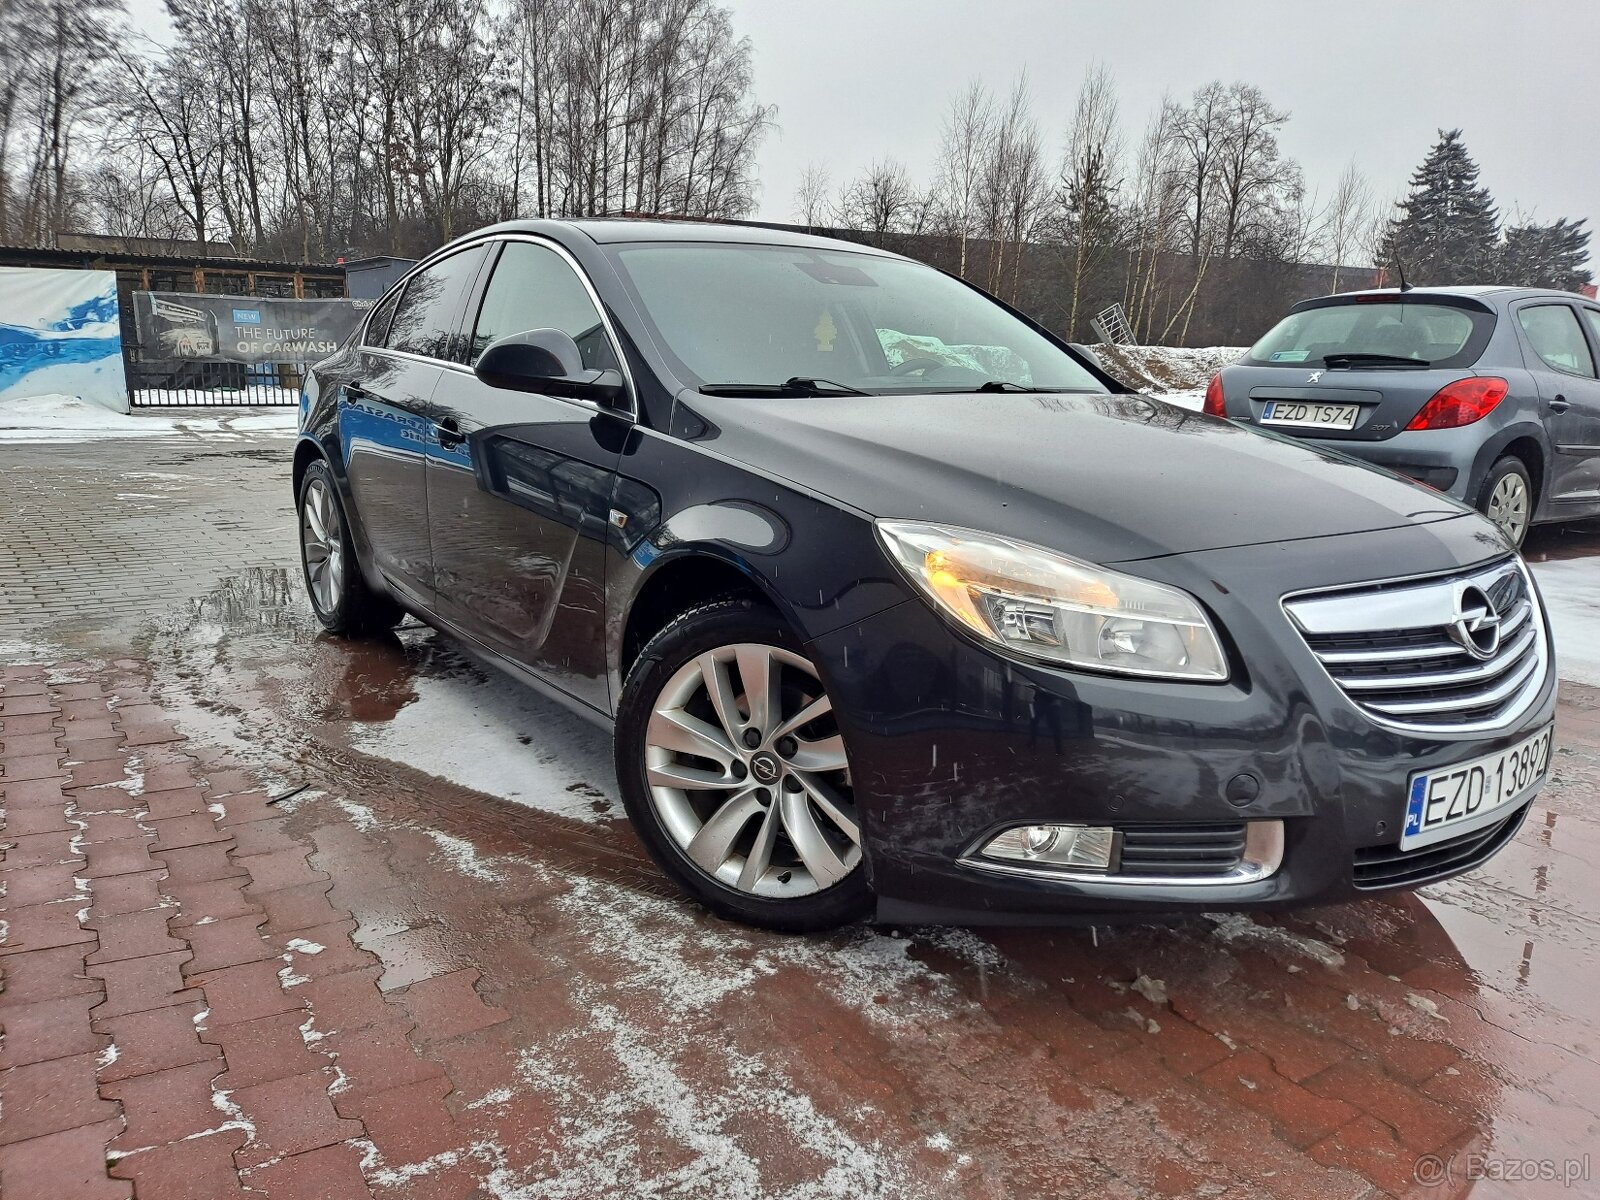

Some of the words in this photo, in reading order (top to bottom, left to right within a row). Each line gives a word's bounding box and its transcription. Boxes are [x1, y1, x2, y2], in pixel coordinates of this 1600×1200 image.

[236, 312, 256, 321] NEW
[235, 326, 261, 340] THE
[266, 327, 315, 340] FUTURE
[236, 341, 260, 354] OF
[262, 341, 338, 354] CARWASH
[1273, 404, 1308, 420] EZD
[1313, 406, 1356, 424] TS74
[1424, 765, 1485, 827] EZD
[1496, 732, 1549, 804] 13892
[1406, 814, 1419, 828] PL
